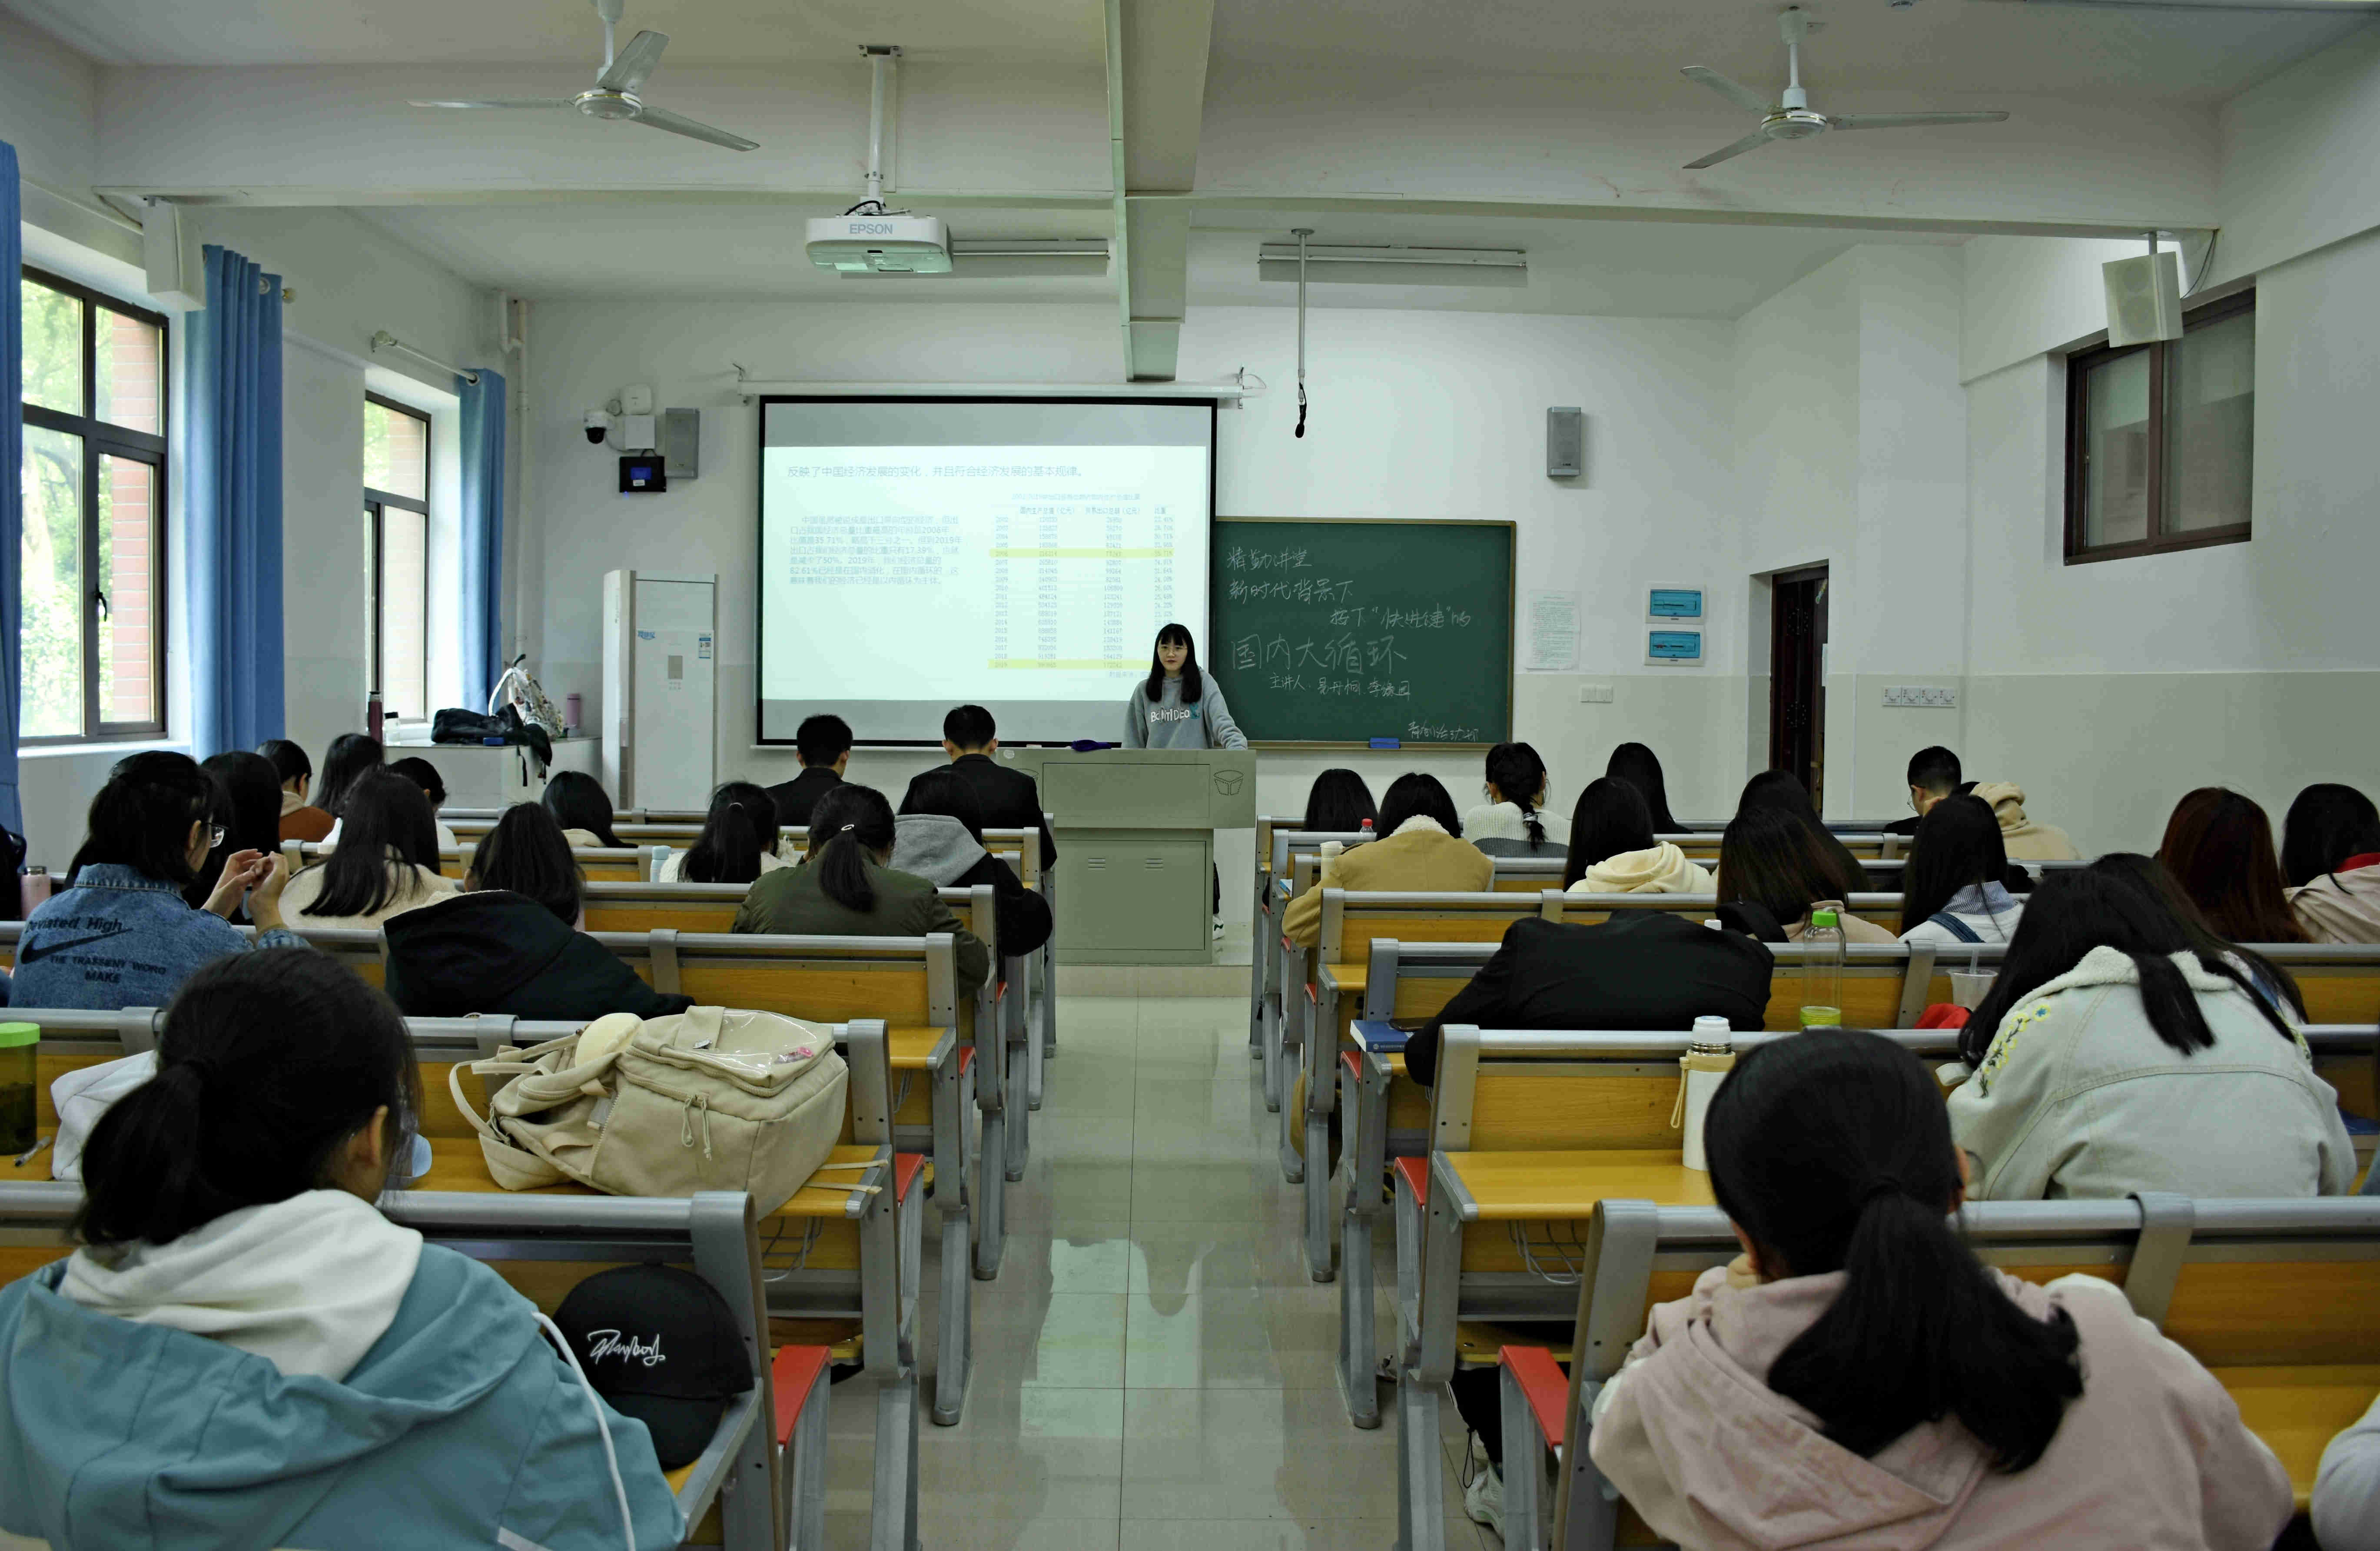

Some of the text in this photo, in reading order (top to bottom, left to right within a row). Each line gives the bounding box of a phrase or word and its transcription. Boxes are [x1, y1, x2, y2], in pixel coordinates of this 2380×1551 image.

[849, 224, 893, 235] EPSON
[1227, 545, 1313, 574] 精勤讲堂
[1228, 578, 1354, 605] 新时代背景下
[1231, 632, 1407, 674] 国内大循环
[86, 917, 122, 933] High
[85, 970, 122, 983] MAKE
